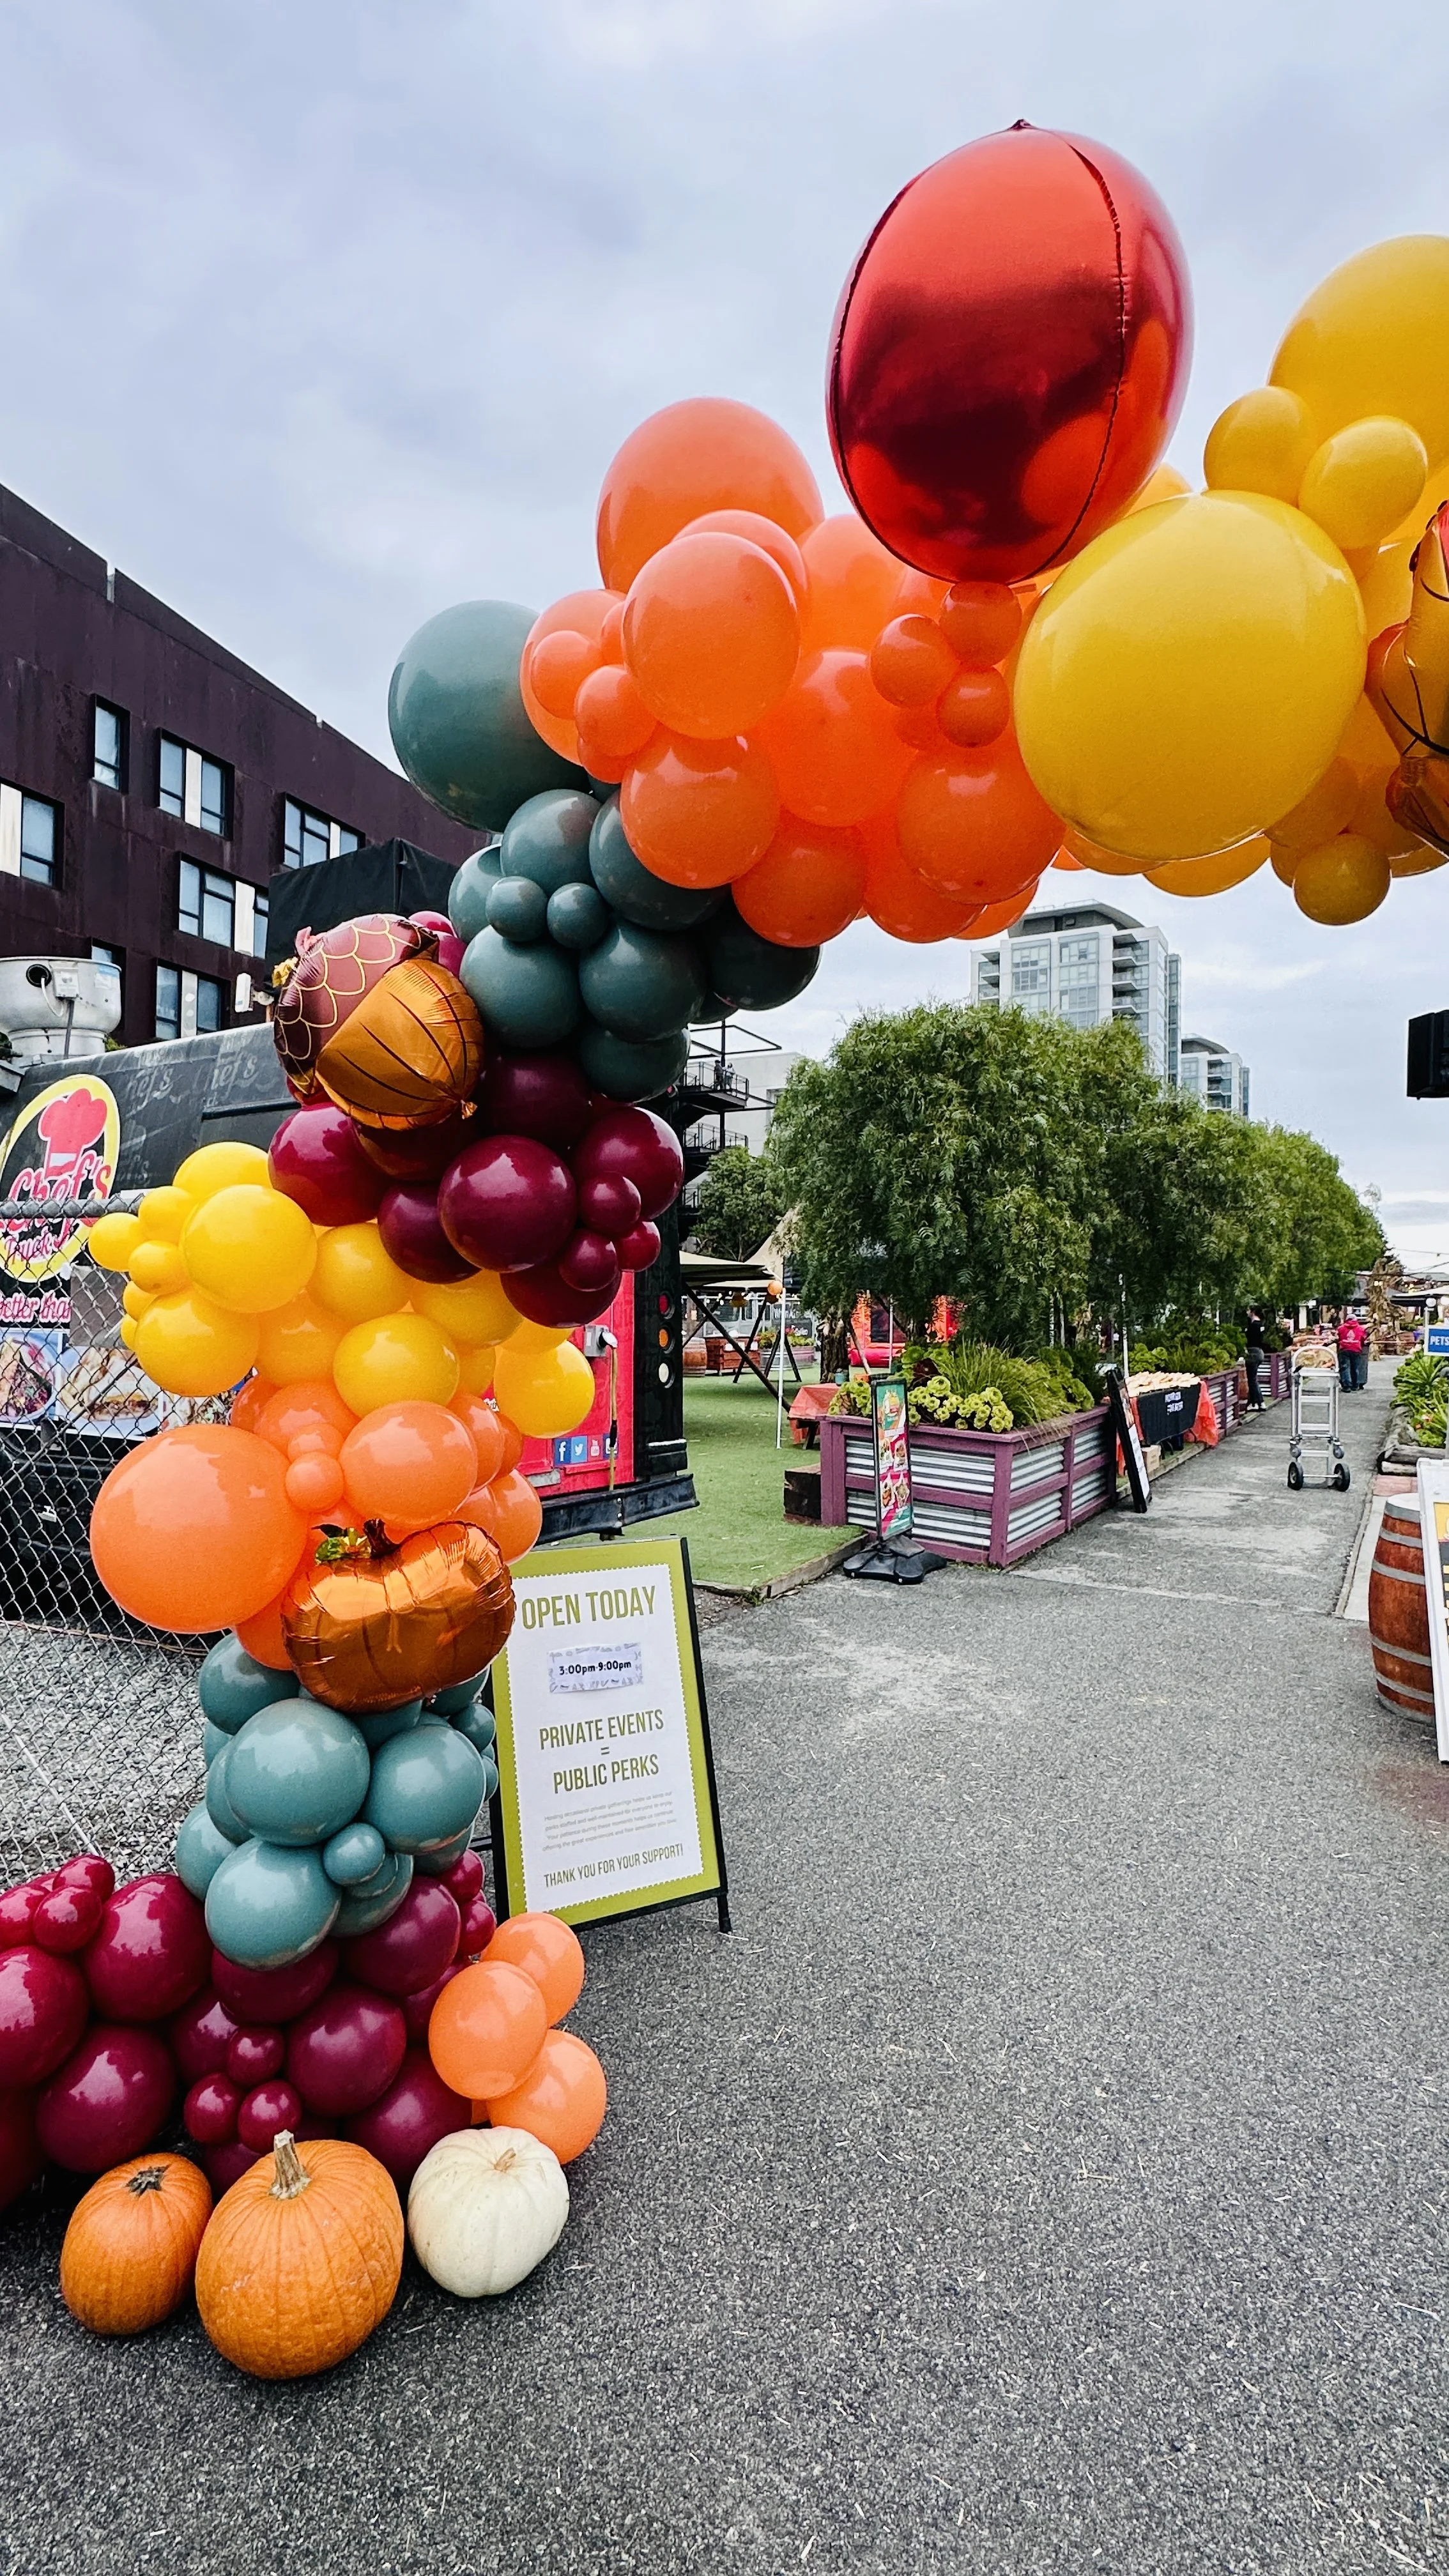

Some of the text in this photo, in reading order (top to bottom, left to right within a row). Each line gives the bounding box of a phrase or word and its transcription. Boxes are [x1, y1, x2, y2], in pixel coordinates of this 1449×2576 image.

[40, 1291, 70, 1321] tha
[521, 1585, 656, 1629] OPEN TODAY
[539, 1709, 664, 1750] PRIVATE EVENTS
[553, 1754, 659, 1794] PUBLIC PERKS
[544, 1843, 684, 1888] THANK YOU FOR YOUR SUPPORT!
